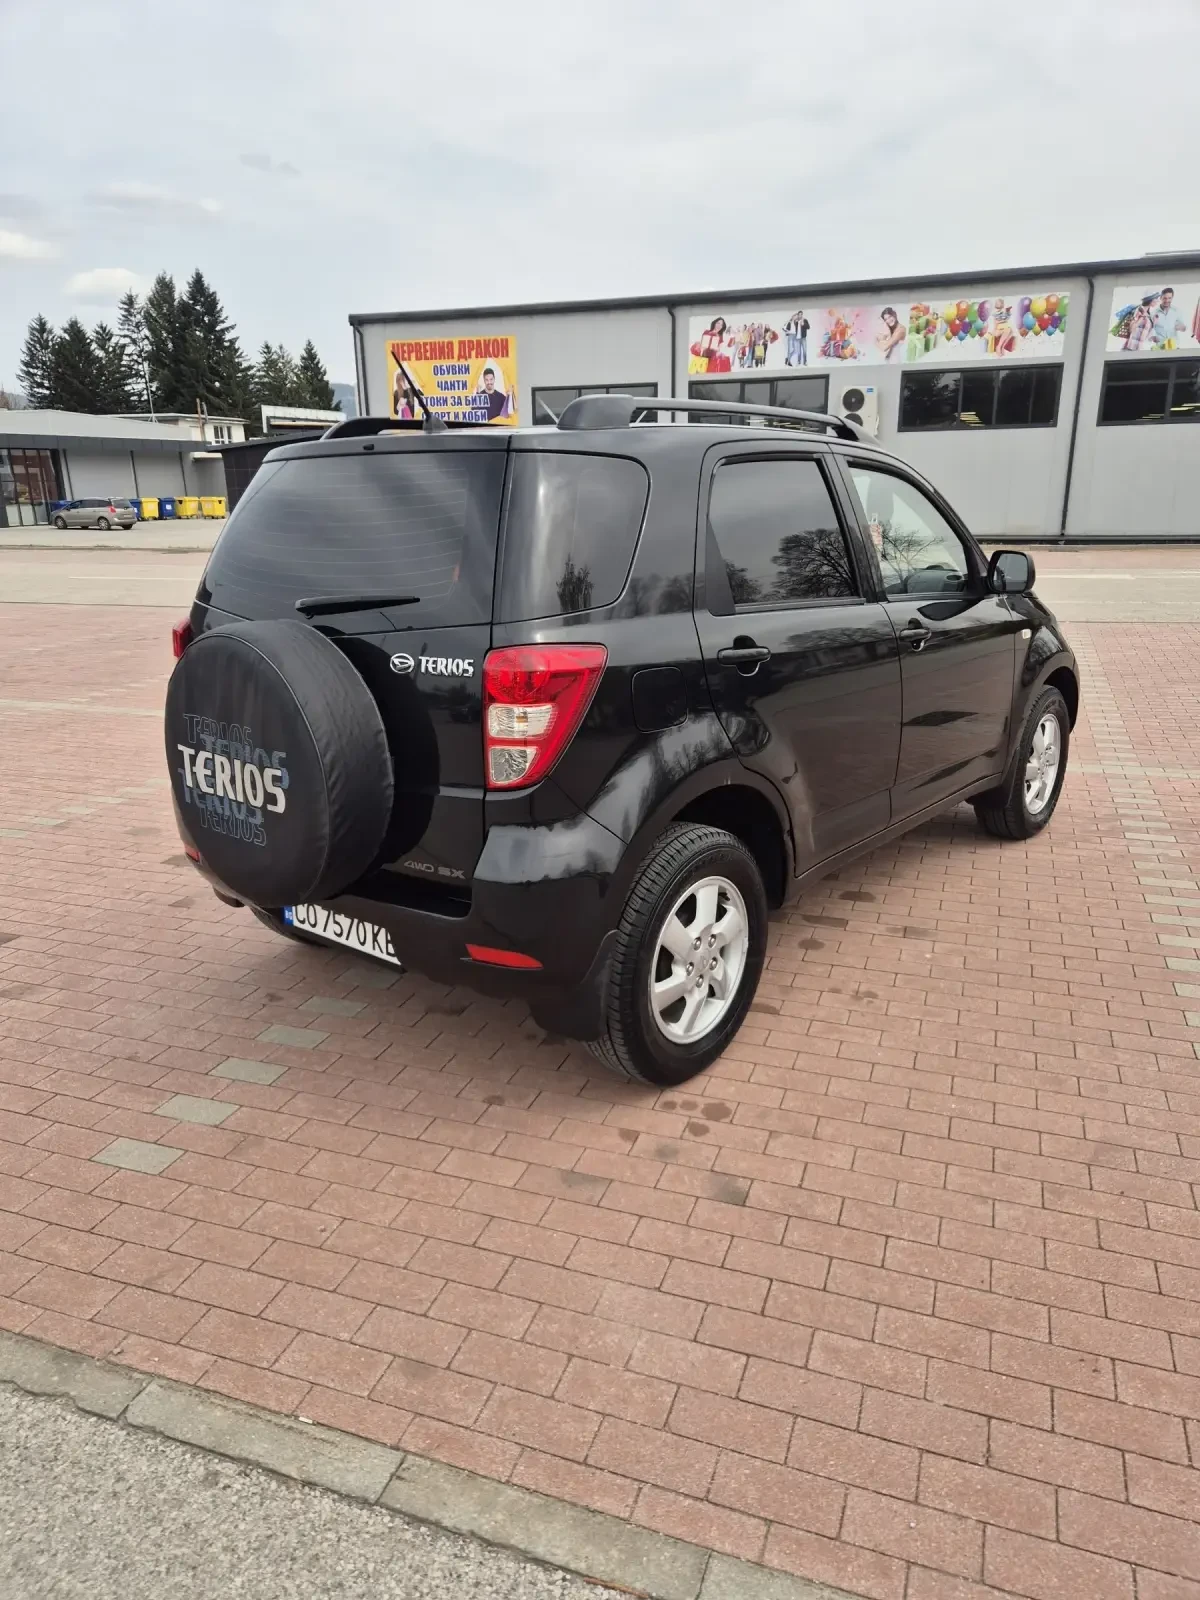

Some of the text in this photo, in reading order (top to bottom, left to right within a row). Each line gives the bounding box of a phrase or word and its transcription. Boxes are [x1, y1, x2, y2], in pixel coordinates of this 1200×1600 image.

[391, 338, 509, 361] ЧЕРВЕНИЯ ДРАКОН
[433, 363, 470, 376] ОБУВКИ
[437, 380, 468, 391] ЧАНТИ
[420, 394, 490, 408] ТОКИ ЗА БИТА
[422, 410, 488, 422] СОРТ И ХОБИ
[418, 656, 474, 677] TERIOS
[177, 743, 286, 814] TERIOS
[403, 860, 435, 873] 4WD
